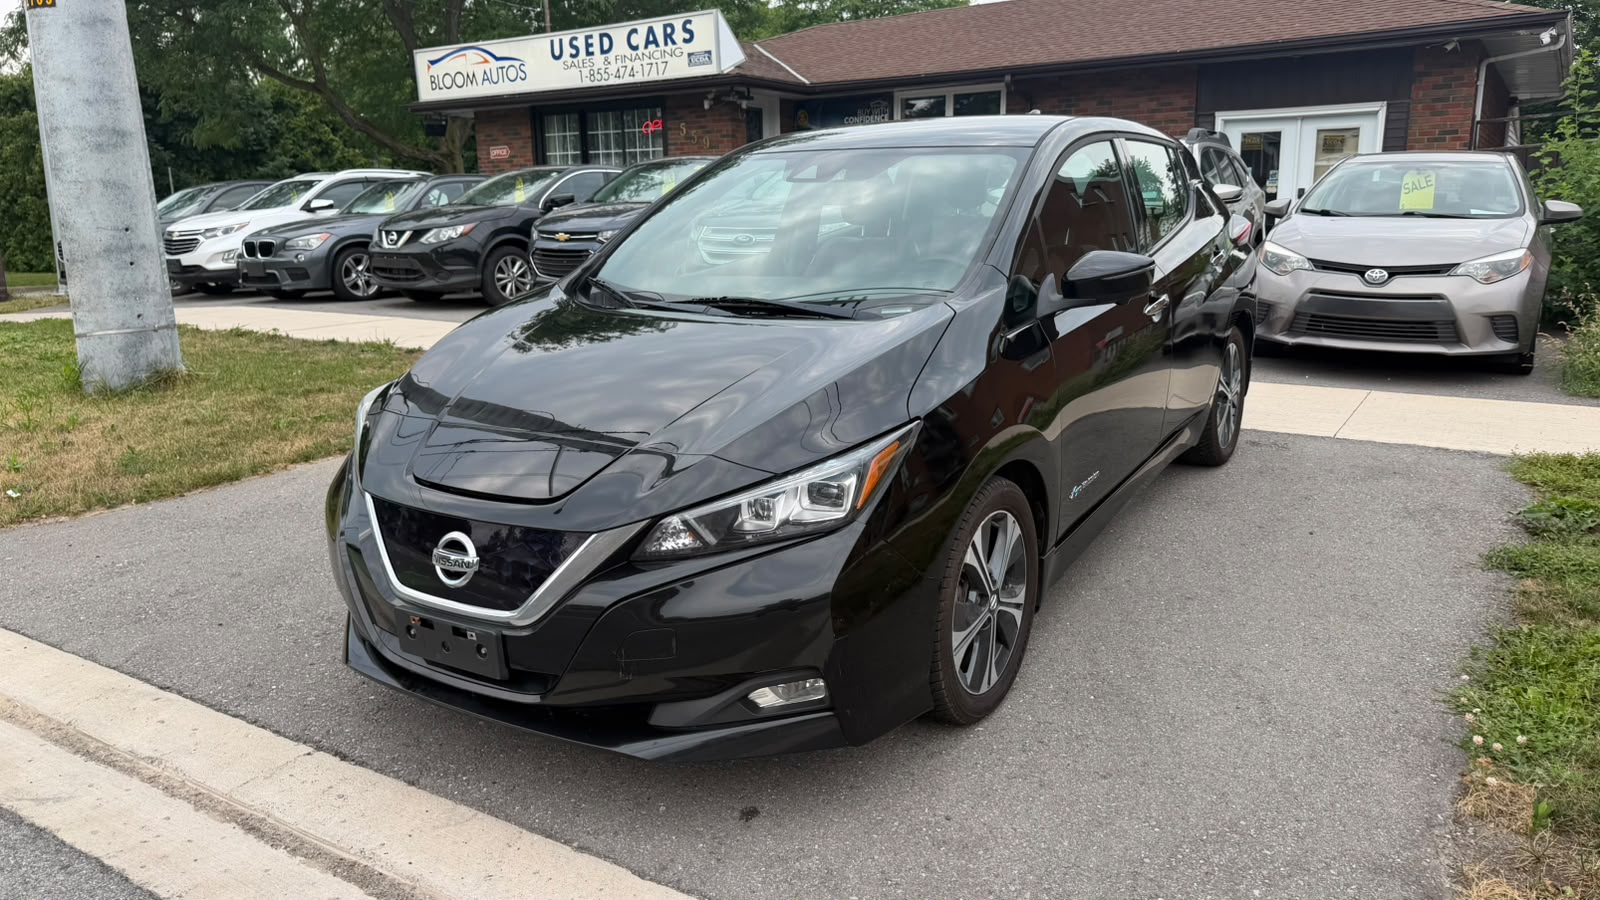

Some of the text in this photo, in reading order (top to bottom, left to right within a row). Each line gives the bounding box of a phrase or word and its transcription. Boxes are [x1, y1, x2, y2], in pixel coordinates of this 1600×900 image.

[550, 19, 695, 61] USED CARS
[563, 47, 684, 71] SALES & FINANCING
[430, 63, 527, 91] BLOOM AUTOS
[578, 61, 669, 84] 1-855-474-1717
[843, 115, 888, 124] CONFIDENCE
[1403, 174, 1434, 195] SALE
[433, 553, 472, 569] NISSAN
